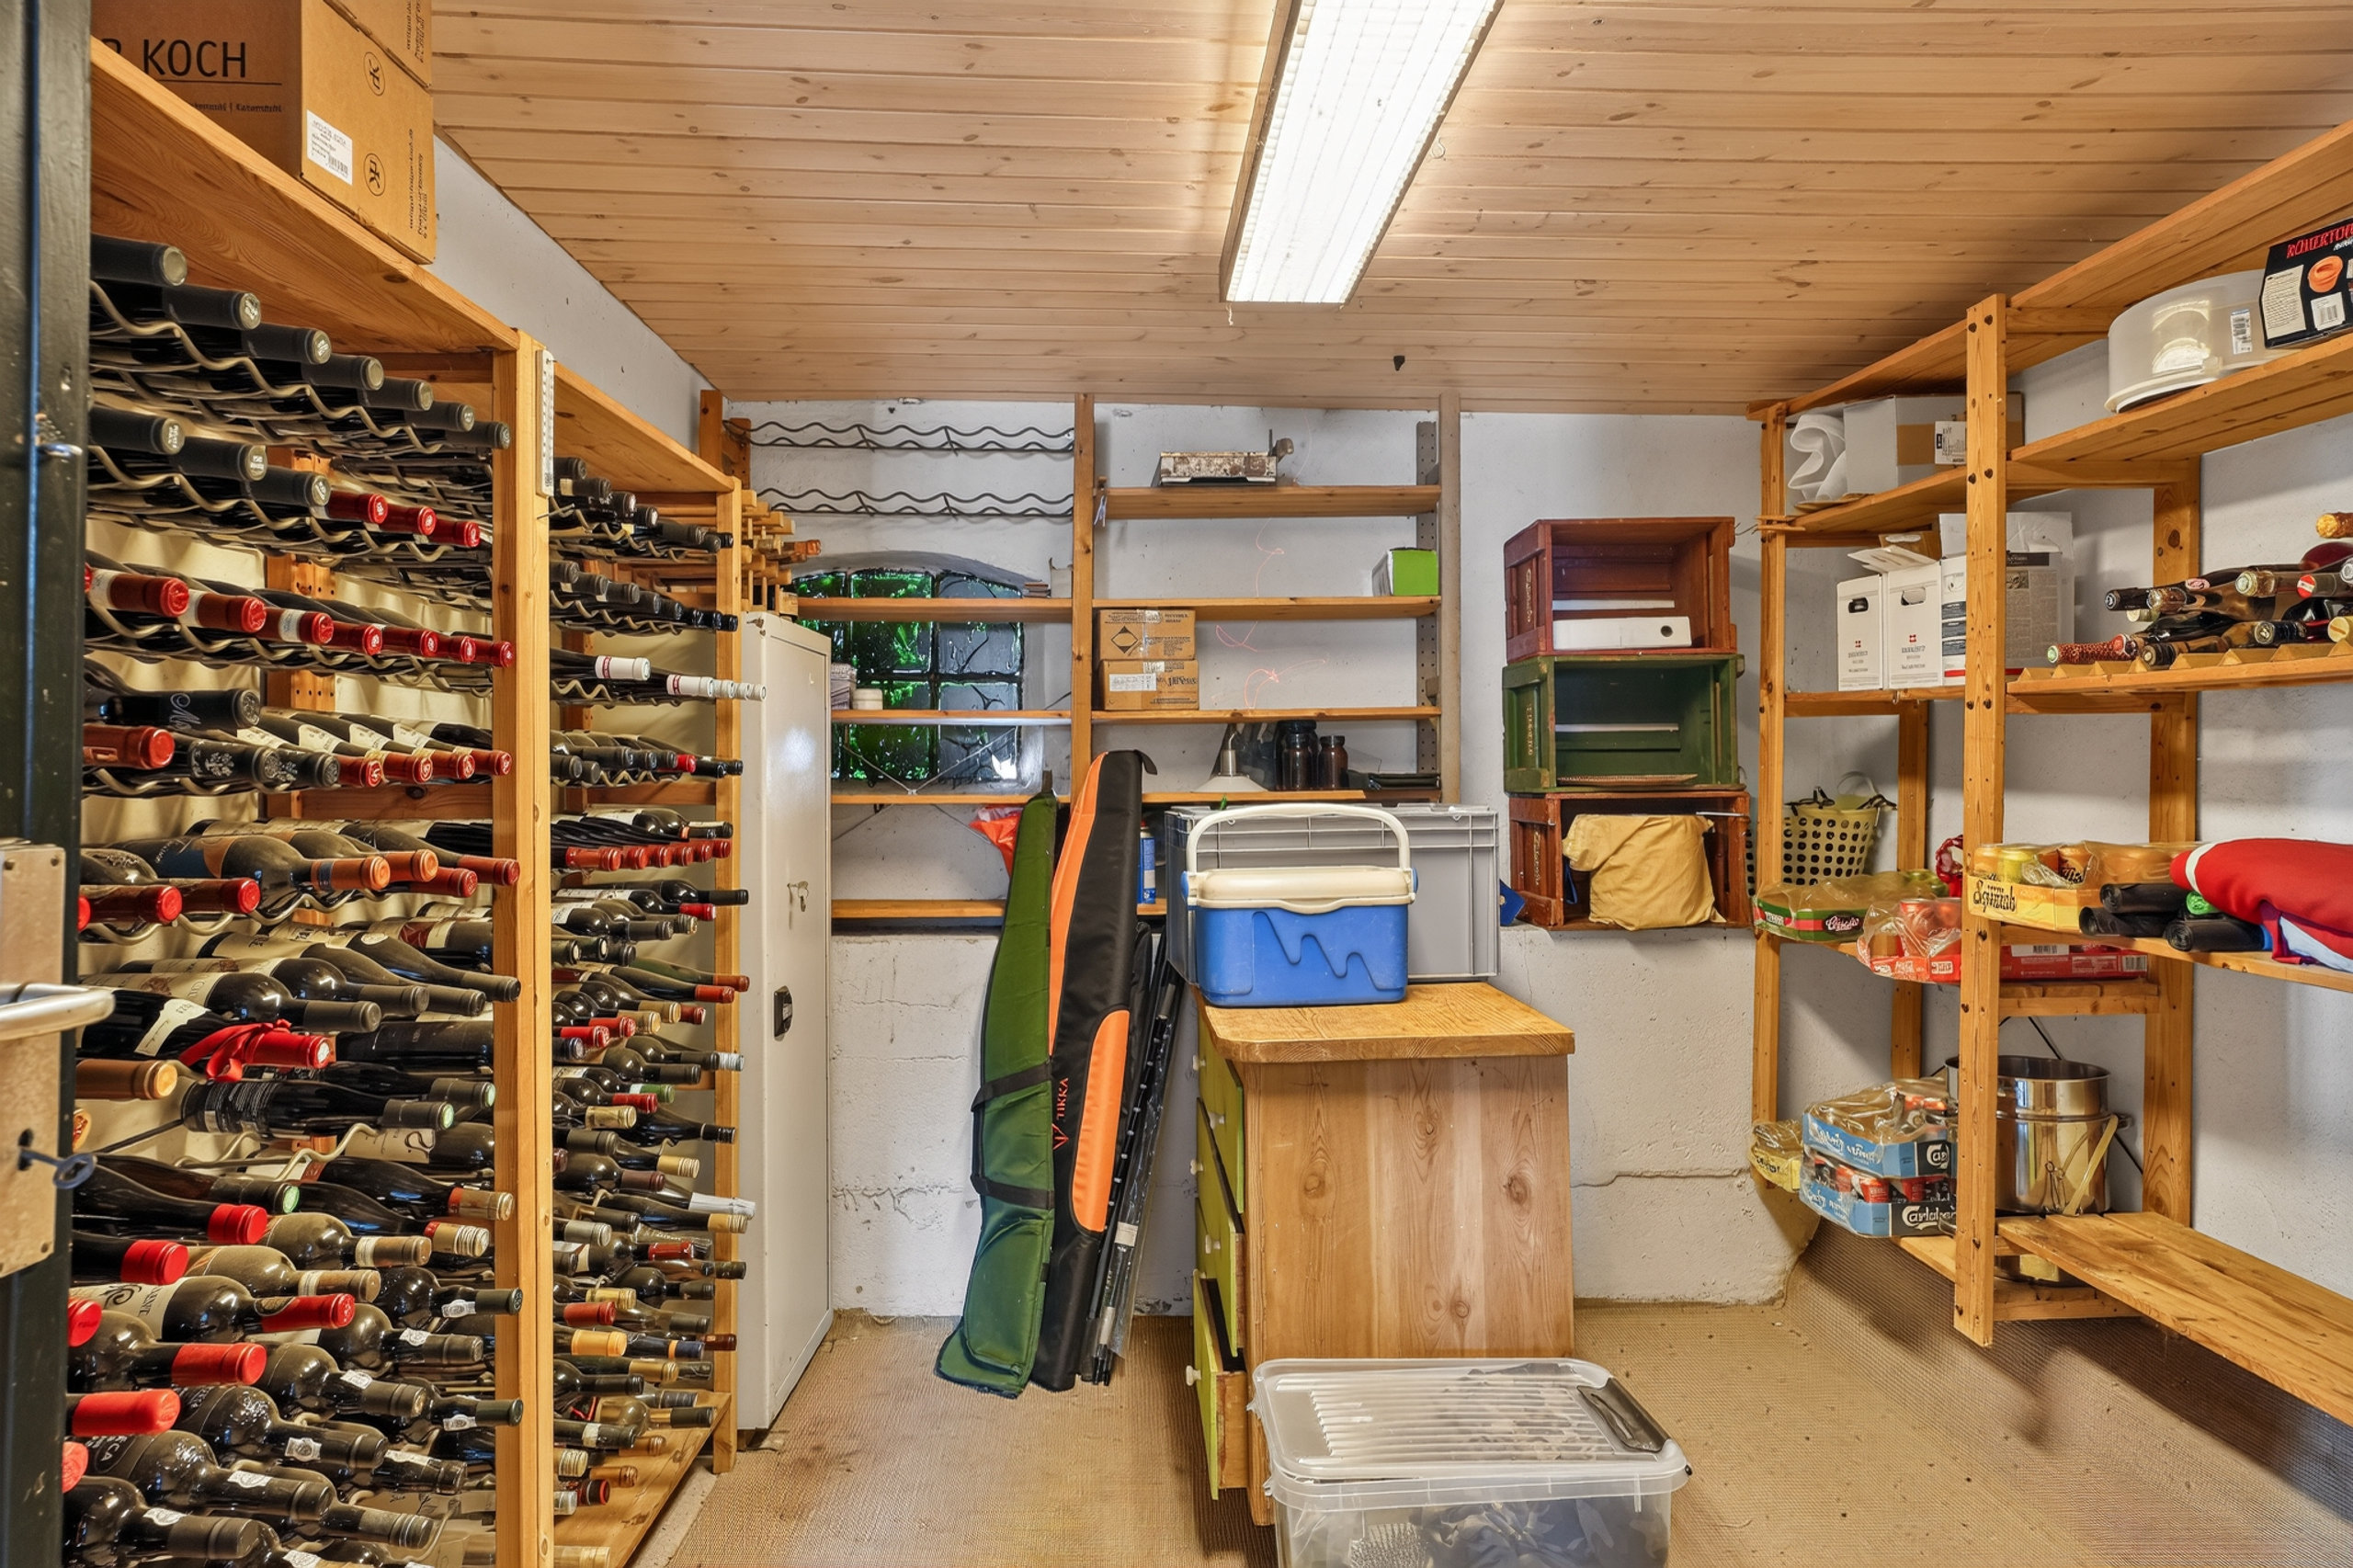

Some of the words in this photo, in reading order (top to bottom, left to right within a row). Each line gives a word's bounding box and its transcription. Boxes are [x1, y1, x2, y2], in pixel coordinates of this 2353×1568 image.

[143, 39, 246, 78] KOCH
[1056, 1077, 1069, 1120] TIKKA
[1902, 1205, 1957, 1231] Carlsber
